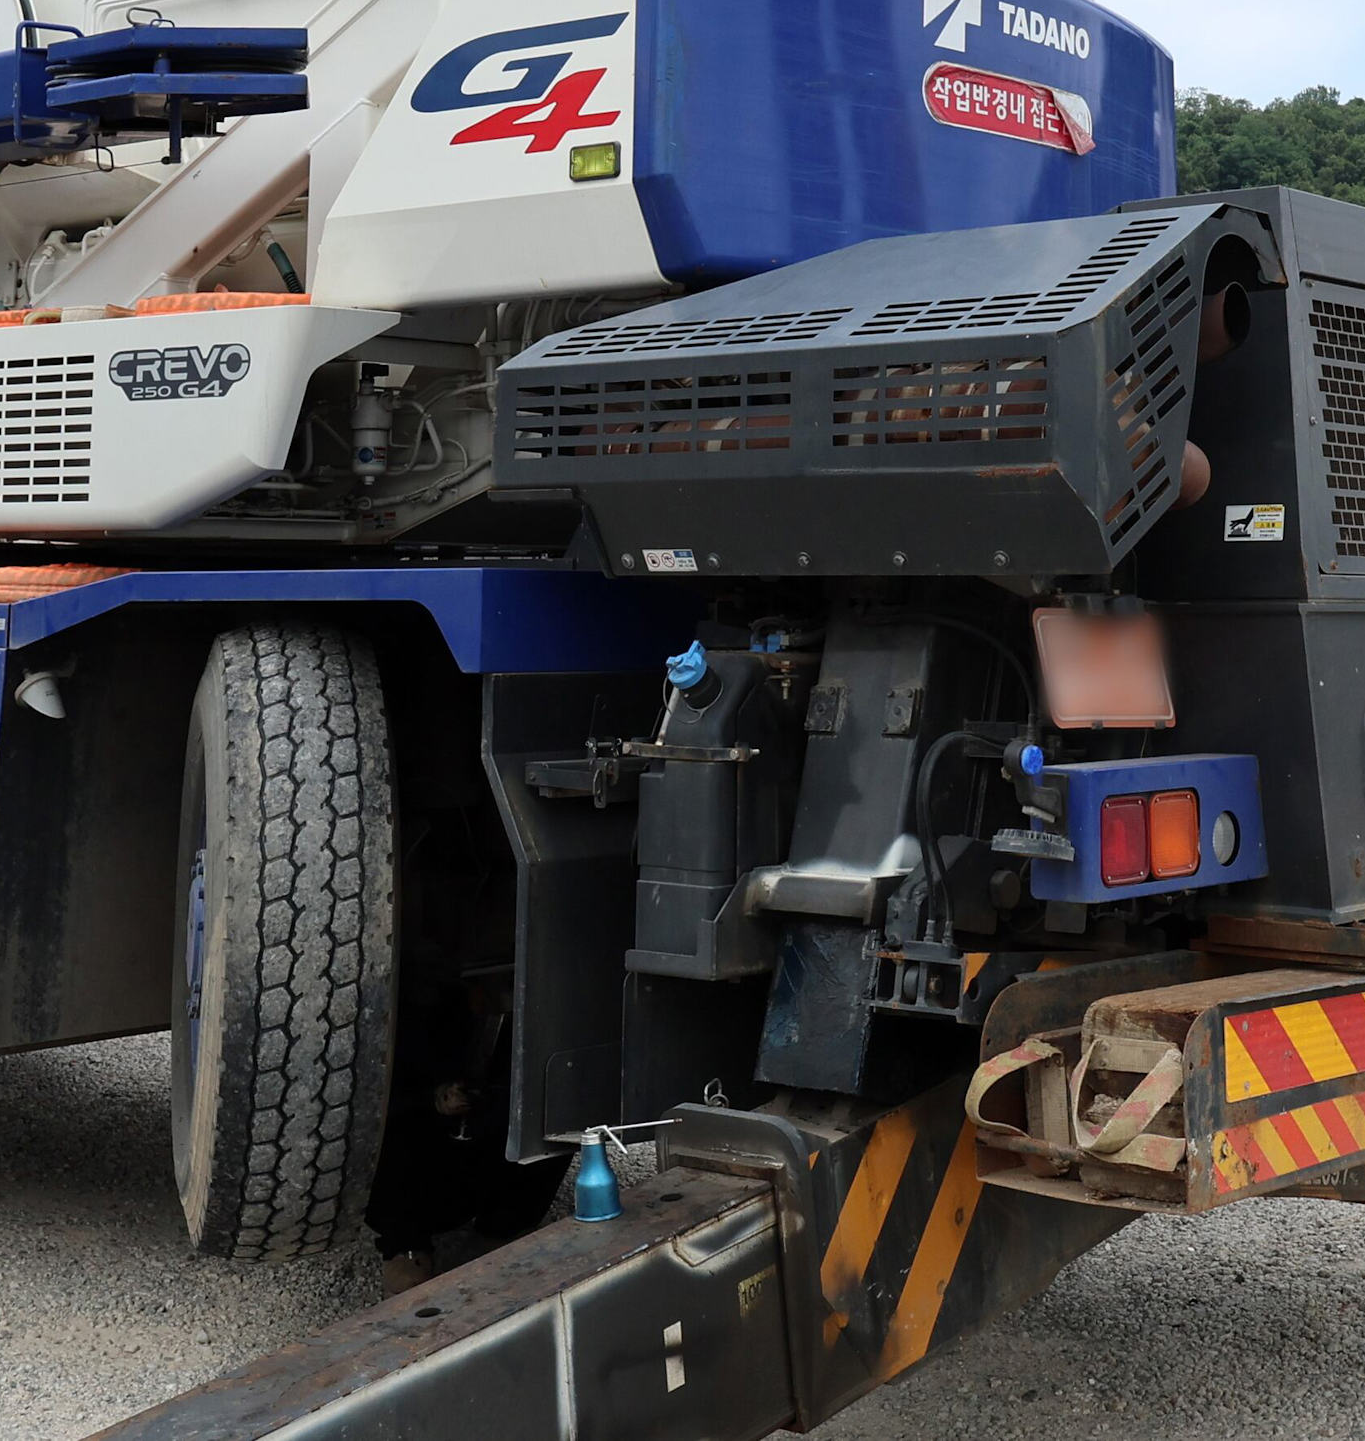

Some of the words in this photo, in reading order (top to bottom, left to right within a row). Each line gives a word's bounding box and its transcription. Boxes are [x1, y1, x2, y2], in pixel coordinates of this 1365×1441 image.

[998, 1, 1090, 59] TADANO
[410, 11, 630, 154] G4
[932, 77, 1025, 124] 작업반경내
[110, 345, 249, 384] CREVO
[131, 386, 172, 399] 250
[177, 380, 223, 398] G4
